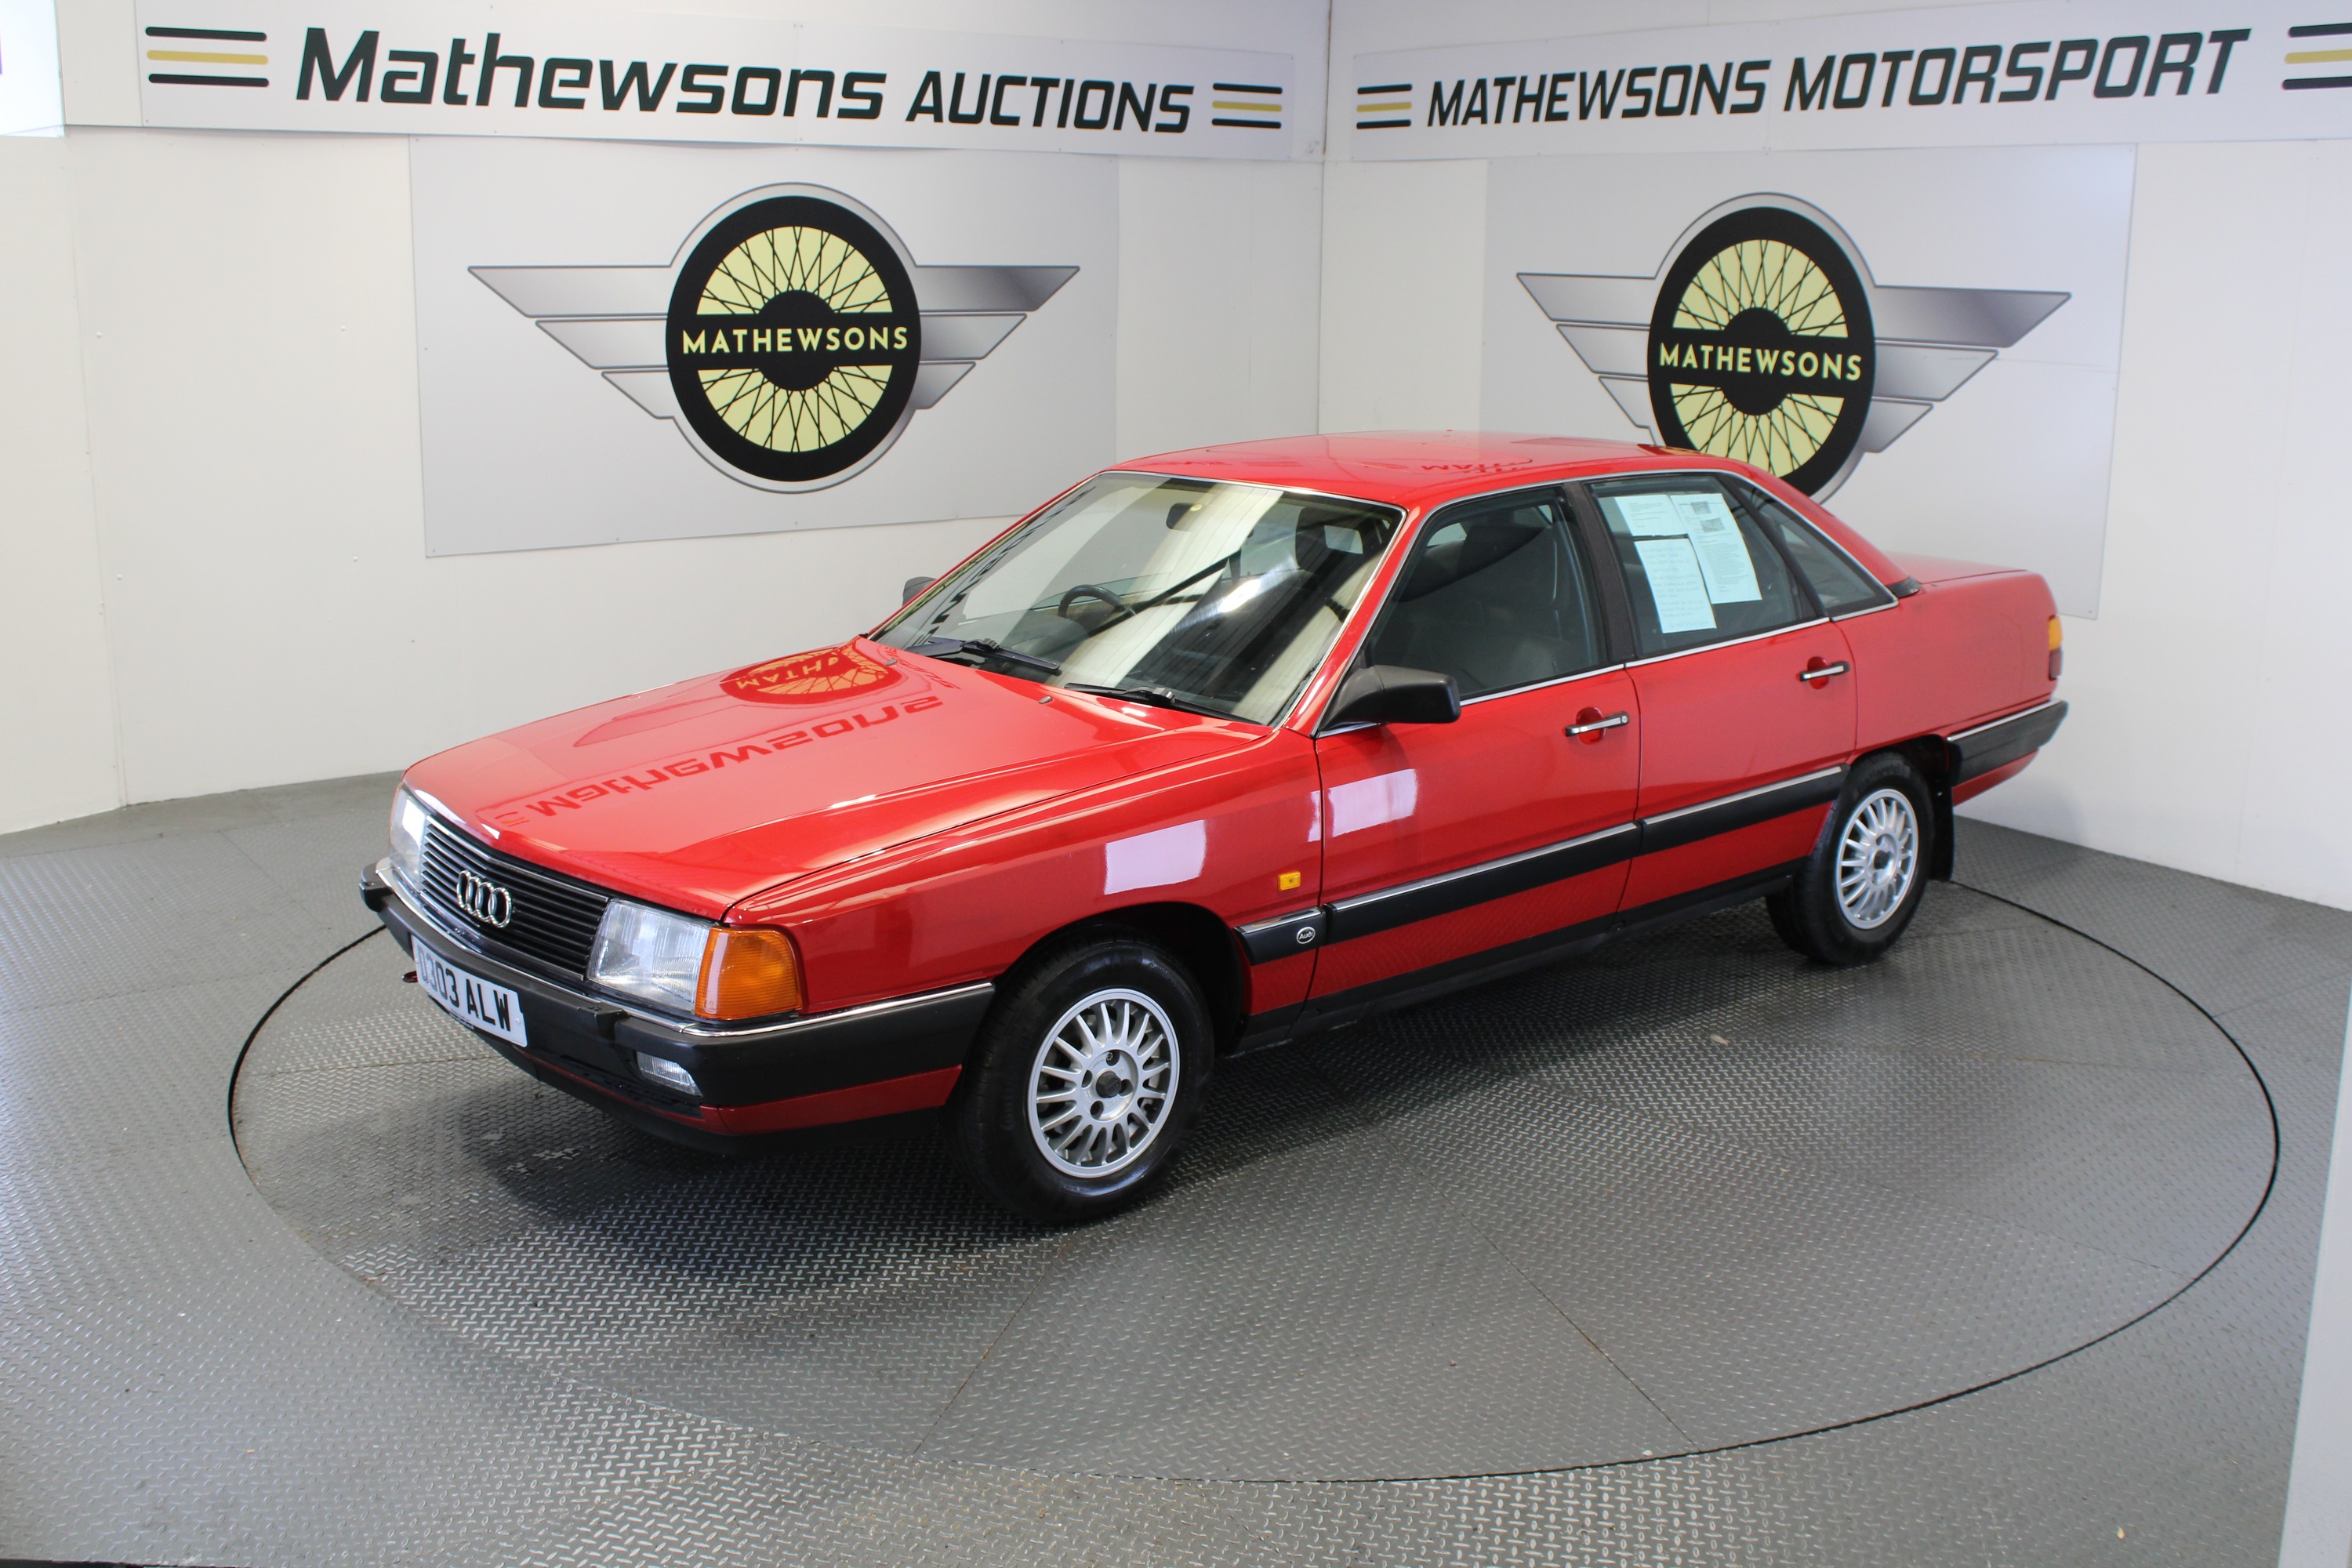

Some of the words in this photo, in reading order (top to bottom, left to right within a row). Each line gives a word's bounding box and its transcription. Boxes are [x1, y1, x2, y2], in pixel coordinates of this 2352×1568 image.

[296, 27, 887, 120] Mathewsons
[905, 71, 1195, 134] AUCTIONS
[1427, 60, 1772, 127] MATHEWSONS
[1784, 28, 2252, 112] MOTORSPORT
[682, 326, 908, 354] MATHEWSONS
[1659, 342, 1862, 381] MATHEWSONS
[466, 978, 511, 1033] ALW
